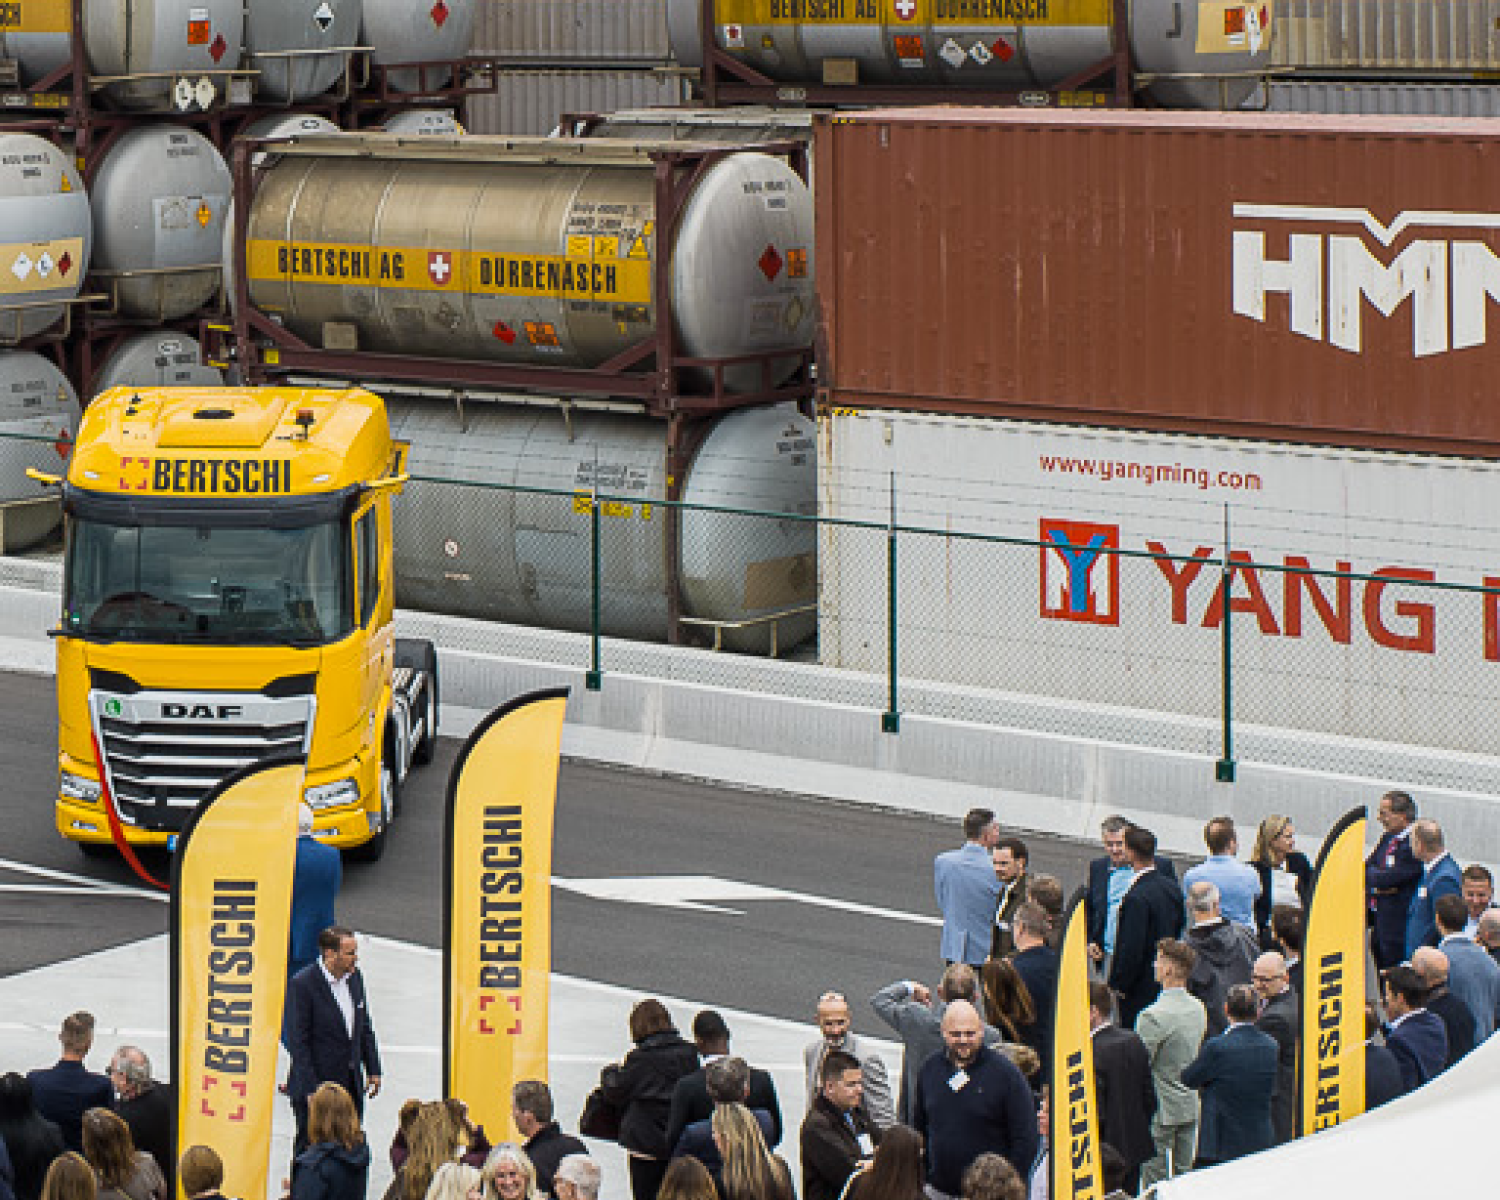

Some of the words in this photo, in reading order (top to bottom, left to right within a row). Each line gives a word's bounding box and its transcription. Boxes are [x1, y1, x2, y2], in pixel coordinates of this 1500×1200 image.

[277, 247, 371, 280] BERTSCHI
[379, 252, 405, 281] AG
[153, 458, 291, 493] BERTSCHI
[1039, 451, 1262, 491] www.yangming.com
[1146, 540, 1437, 655] YANG
[161, 703, 243, 719] DAF
[480, 805, 522, 989] BERTSCHI
[205, 880, 258, 1076] BERTSCHI
[1314, 950, 1343, 1133] ERTSCHI
[1068, 1050, 1096, 1200] TSCHI
